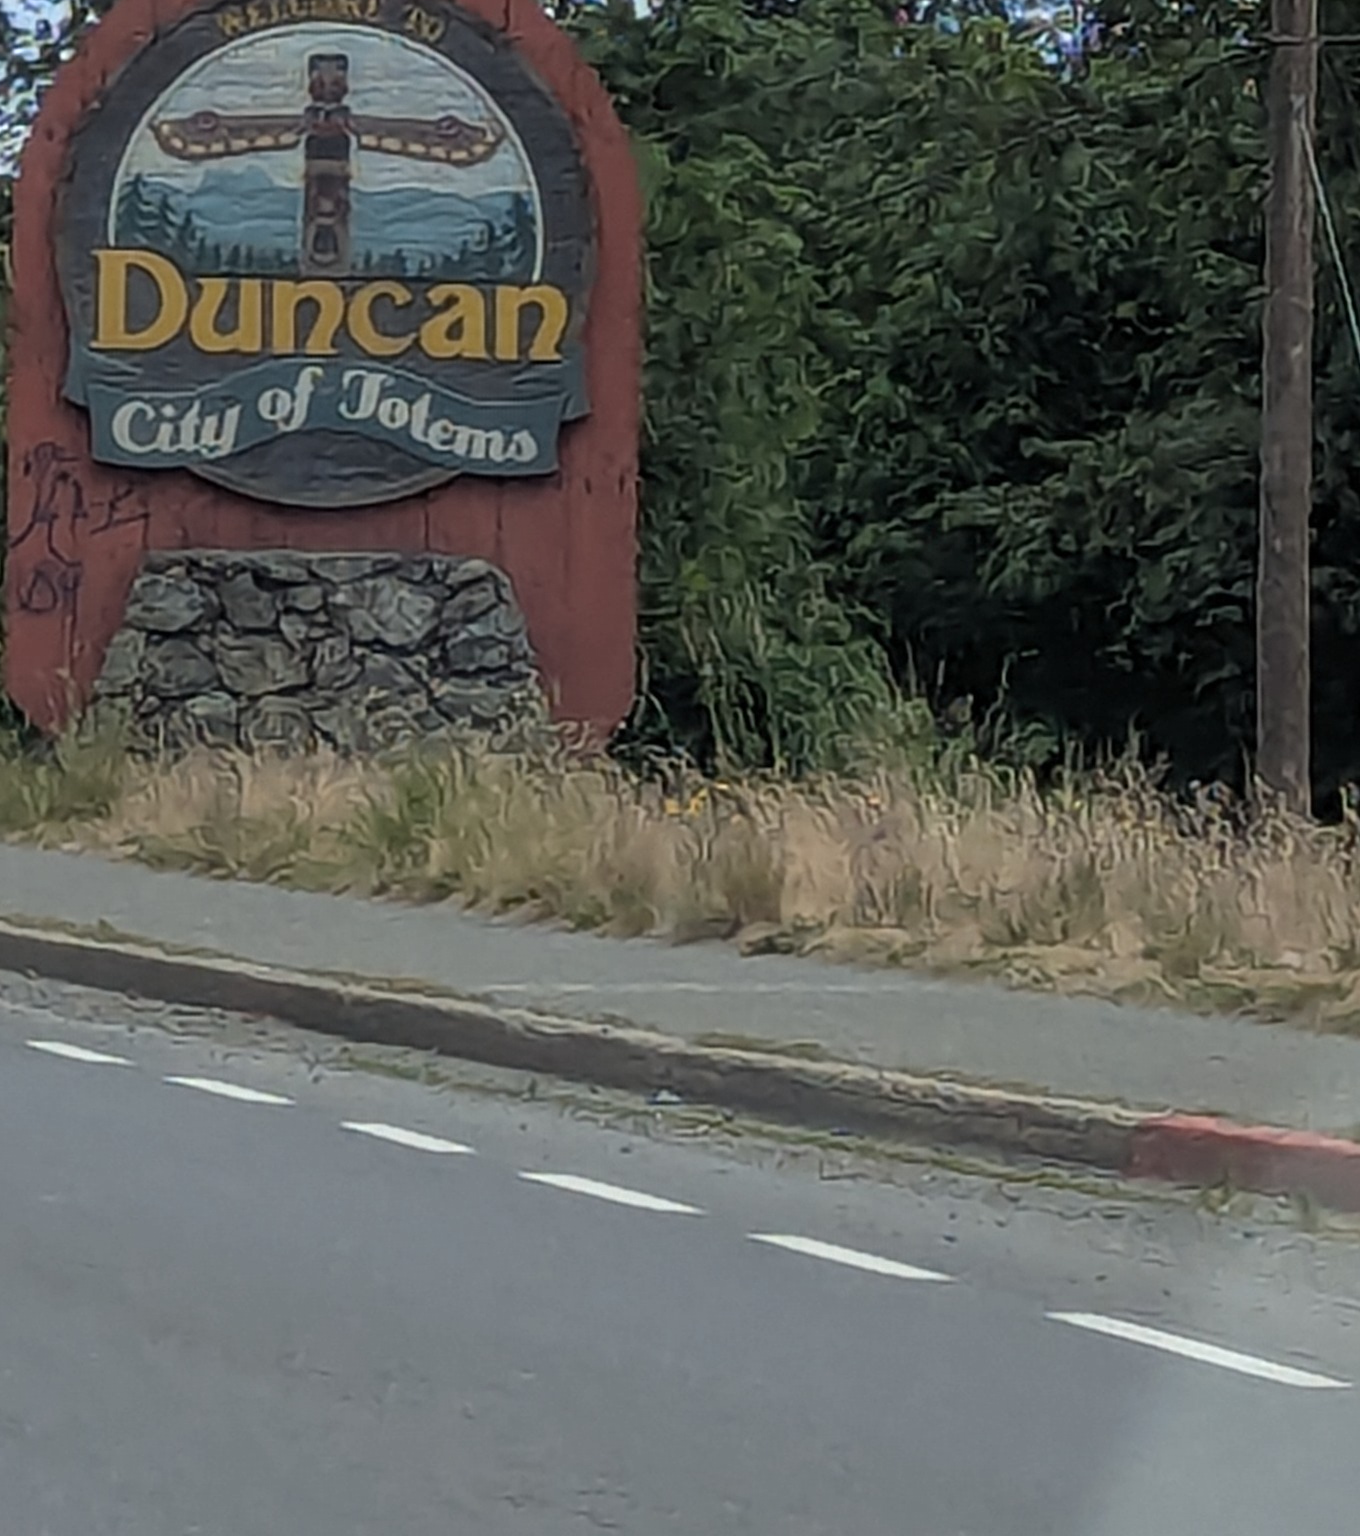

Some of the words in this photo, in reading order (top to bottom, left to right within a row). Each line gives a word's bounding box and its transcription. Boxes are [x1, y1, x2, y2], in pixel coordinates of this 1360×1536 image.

[89, 249, 569, 361] Duncan
[111, 399, 241, 458] City
[257, 366, 324, 431] of
[338, 368, 539, 462] Totems
